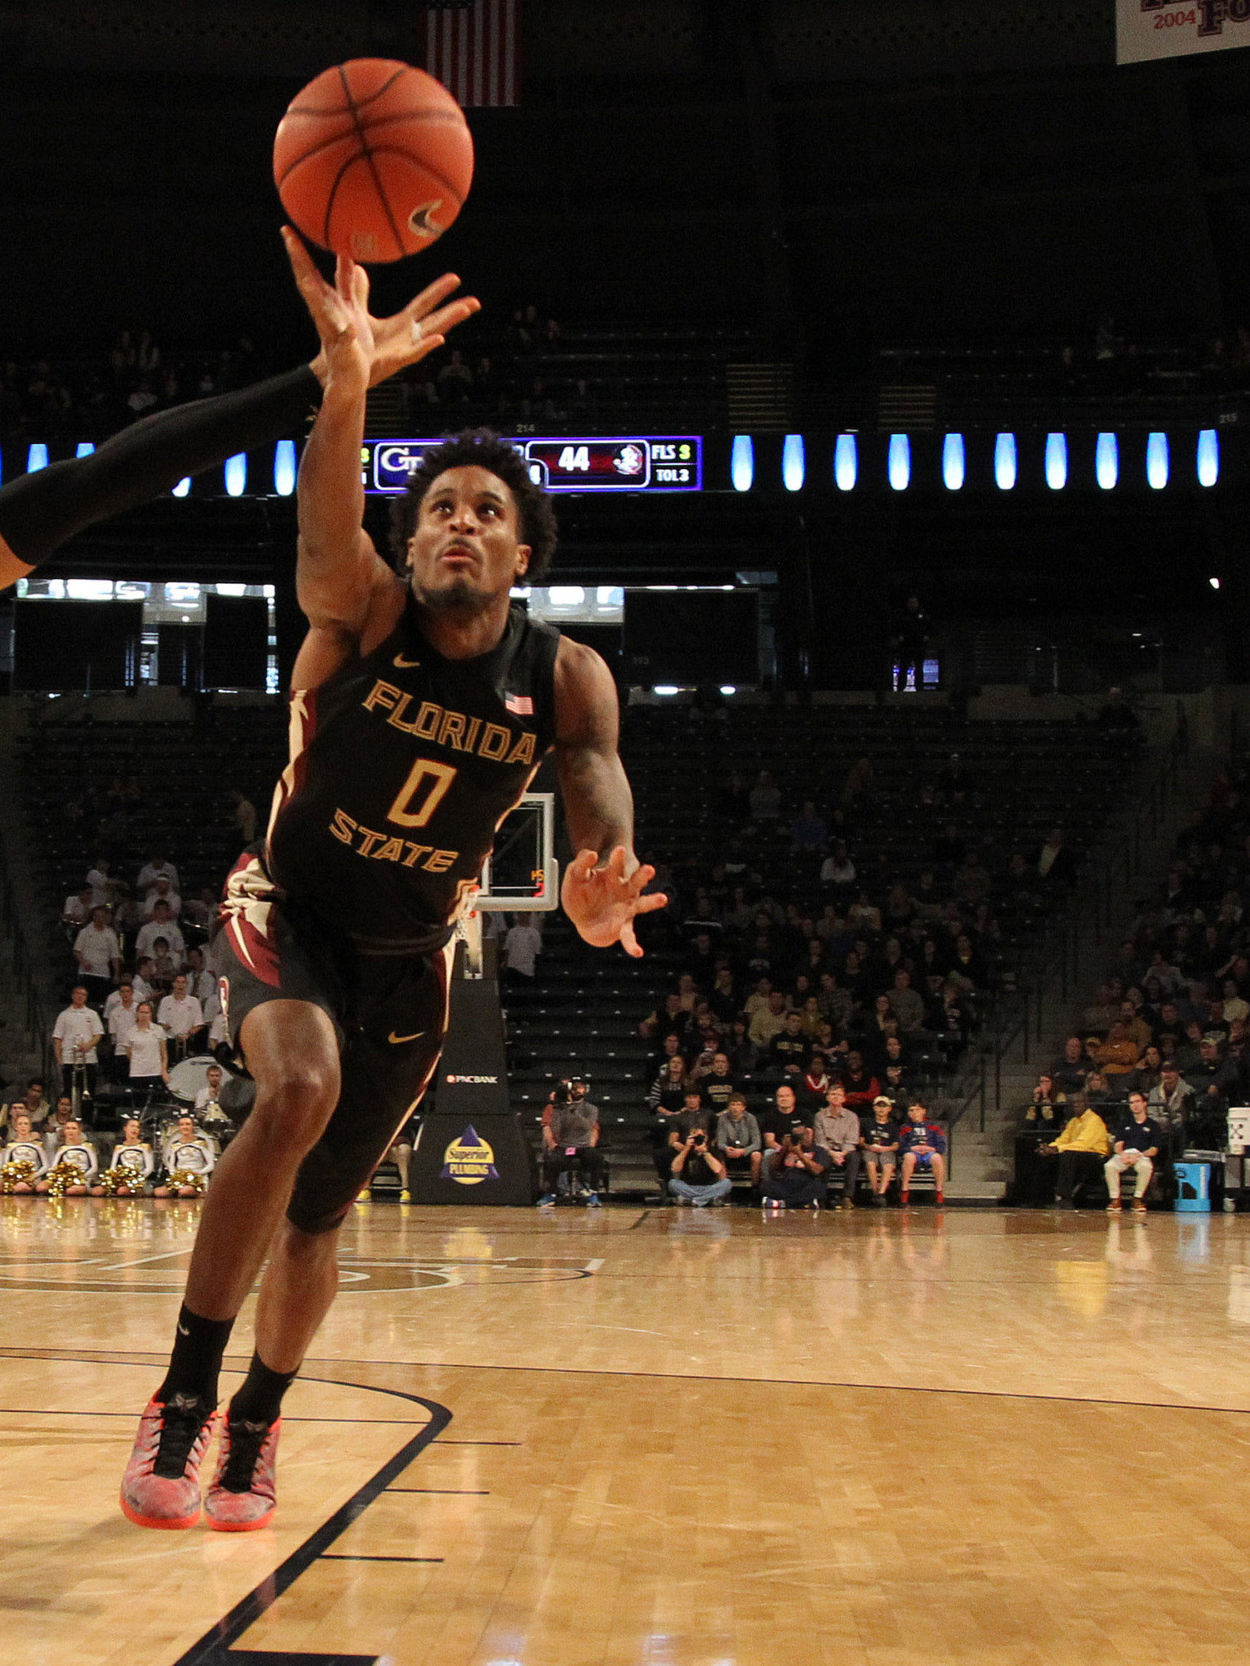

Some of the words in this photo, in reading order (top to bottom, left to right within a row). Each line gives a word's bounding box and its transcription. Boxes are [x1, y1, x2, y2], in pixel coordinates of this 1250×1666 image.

[1153, 9, 1196, 29] 2004
[558, 446, 591, 472] 44
[652, 445, 676, 460] FLS
[361, 678, 537, 765] FLORIDA
[386, 757, 458, 828] 0
[328, 807, 460, 873] STATE
